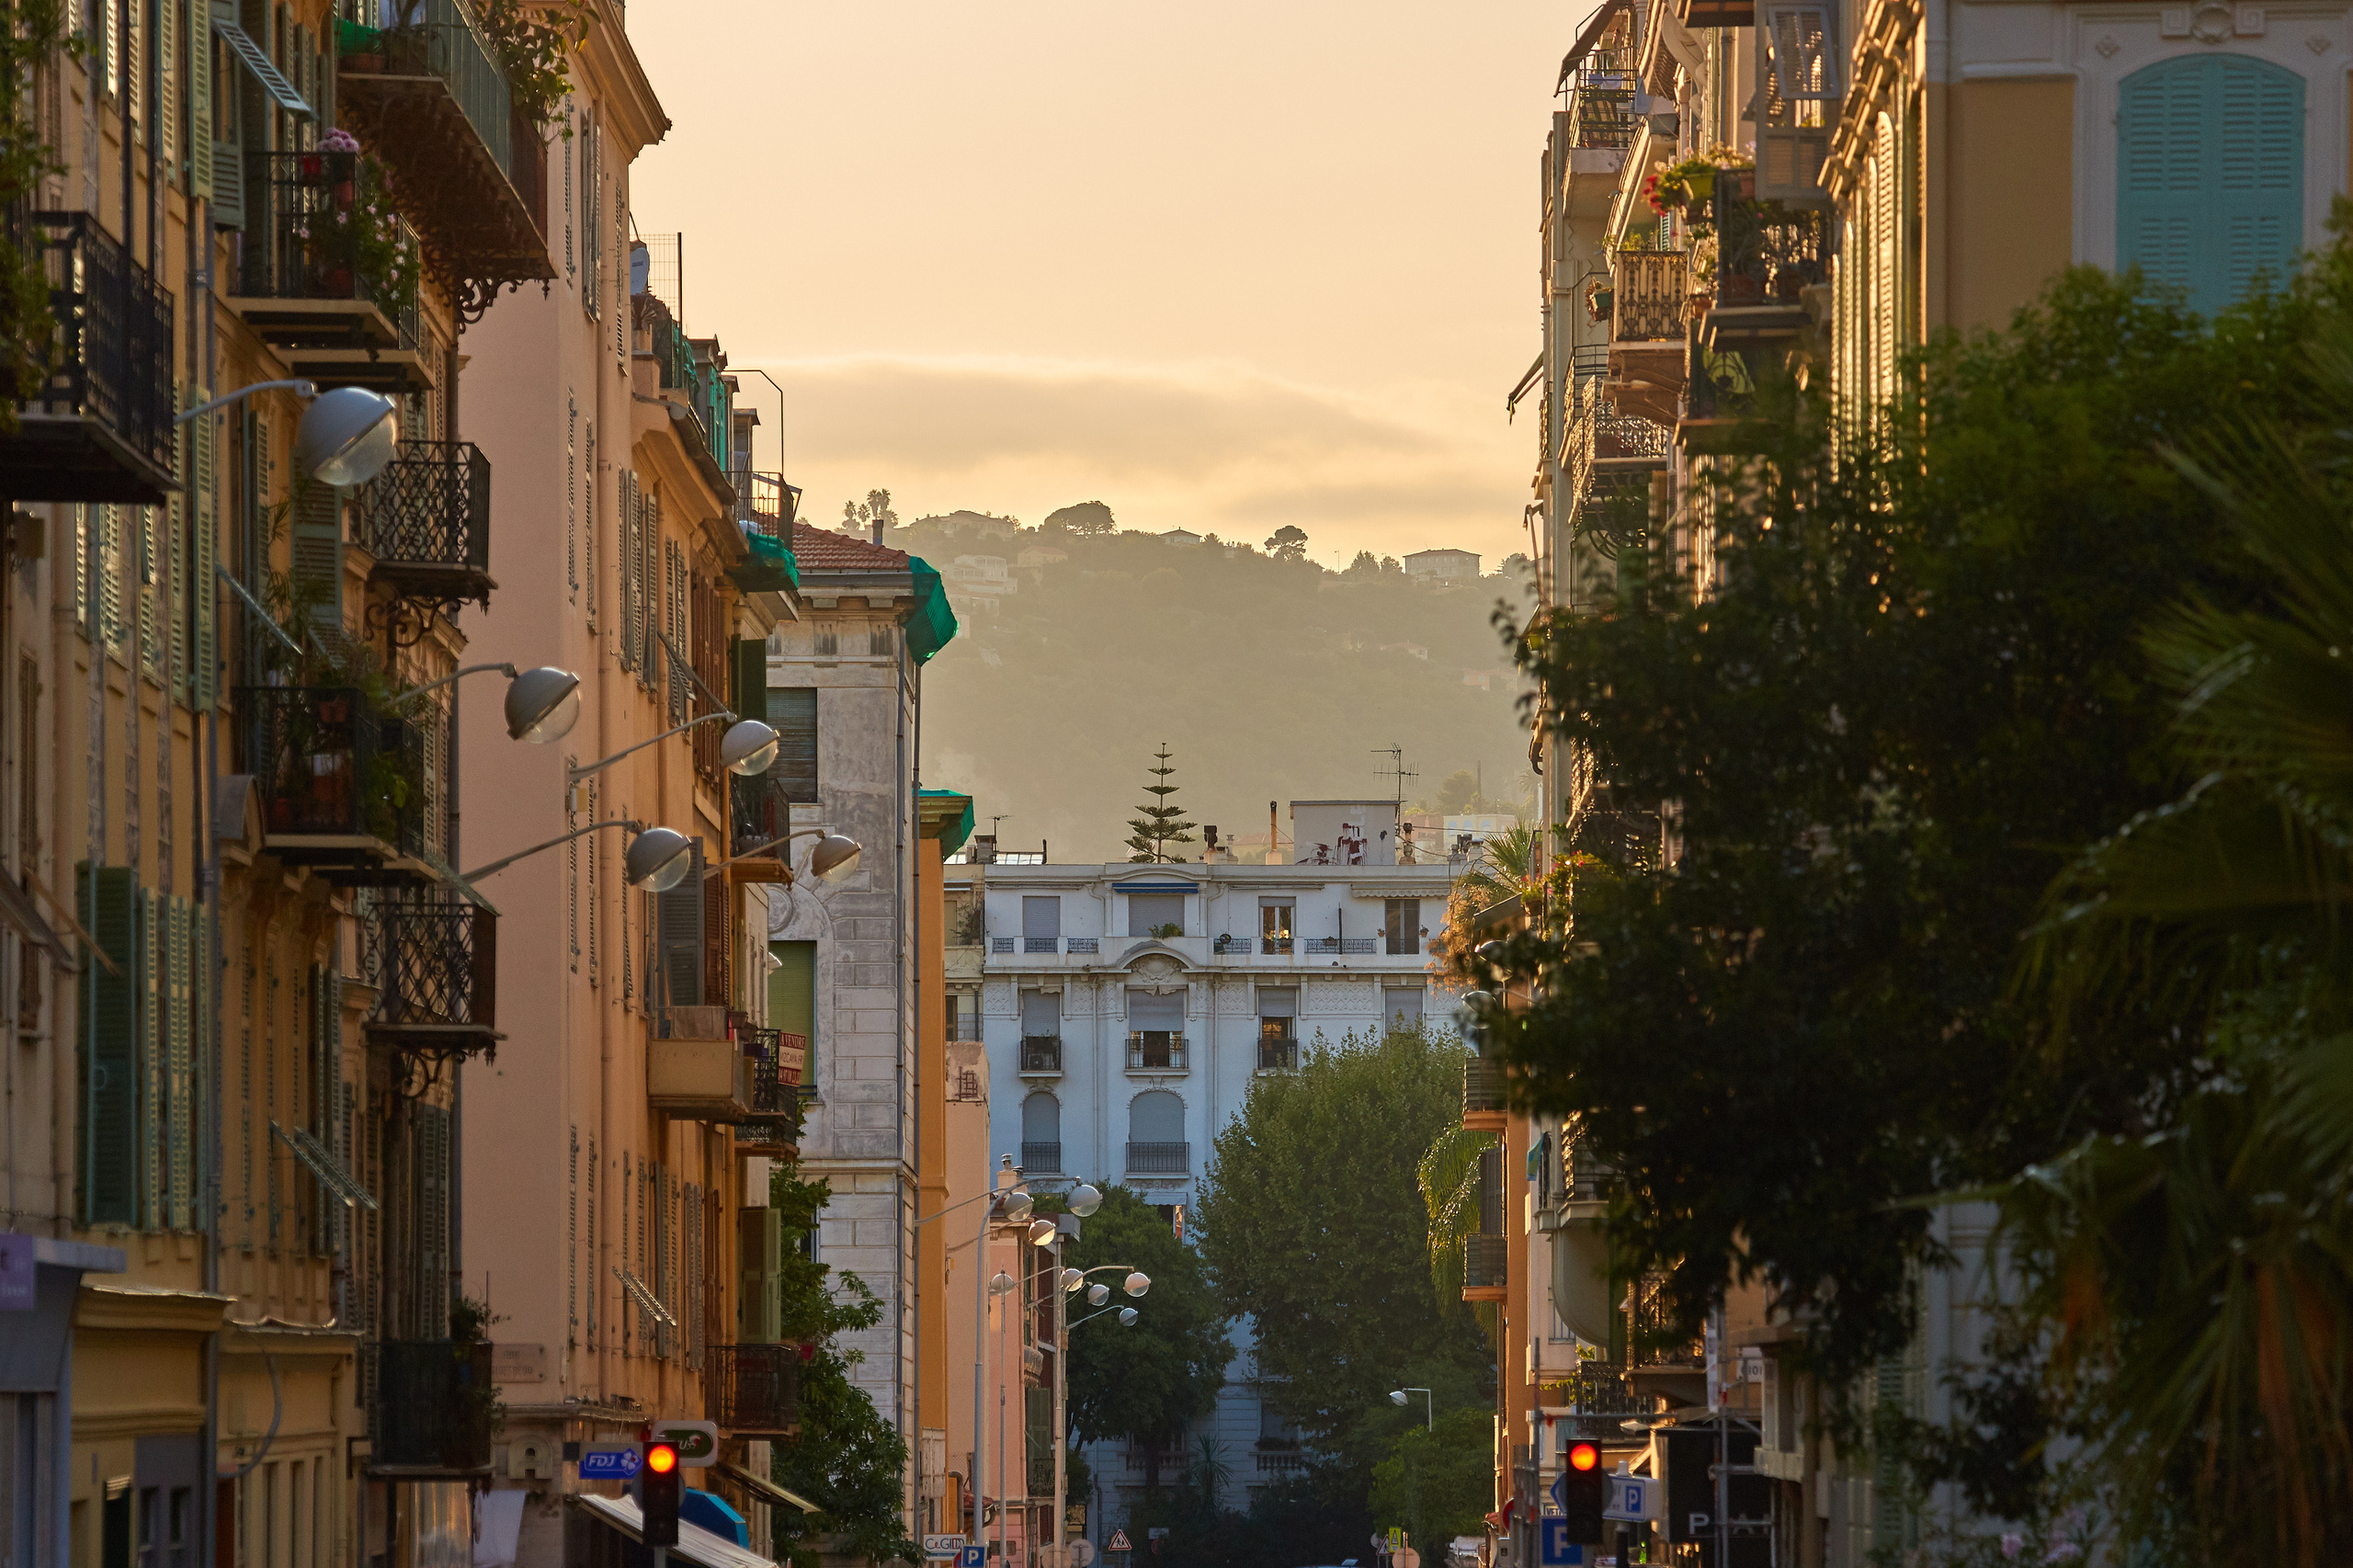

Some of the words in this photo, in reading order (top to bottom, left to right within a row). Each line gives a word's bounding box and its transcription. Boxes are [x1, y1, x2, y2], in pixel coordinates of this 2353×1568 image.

[785, 1034, 805, 1048] VENDRE
[588, 1456, 616, 1467] FDJ
[1629, 1489, 1638, 1510] P
[968, 1550, 979, 1564] P
